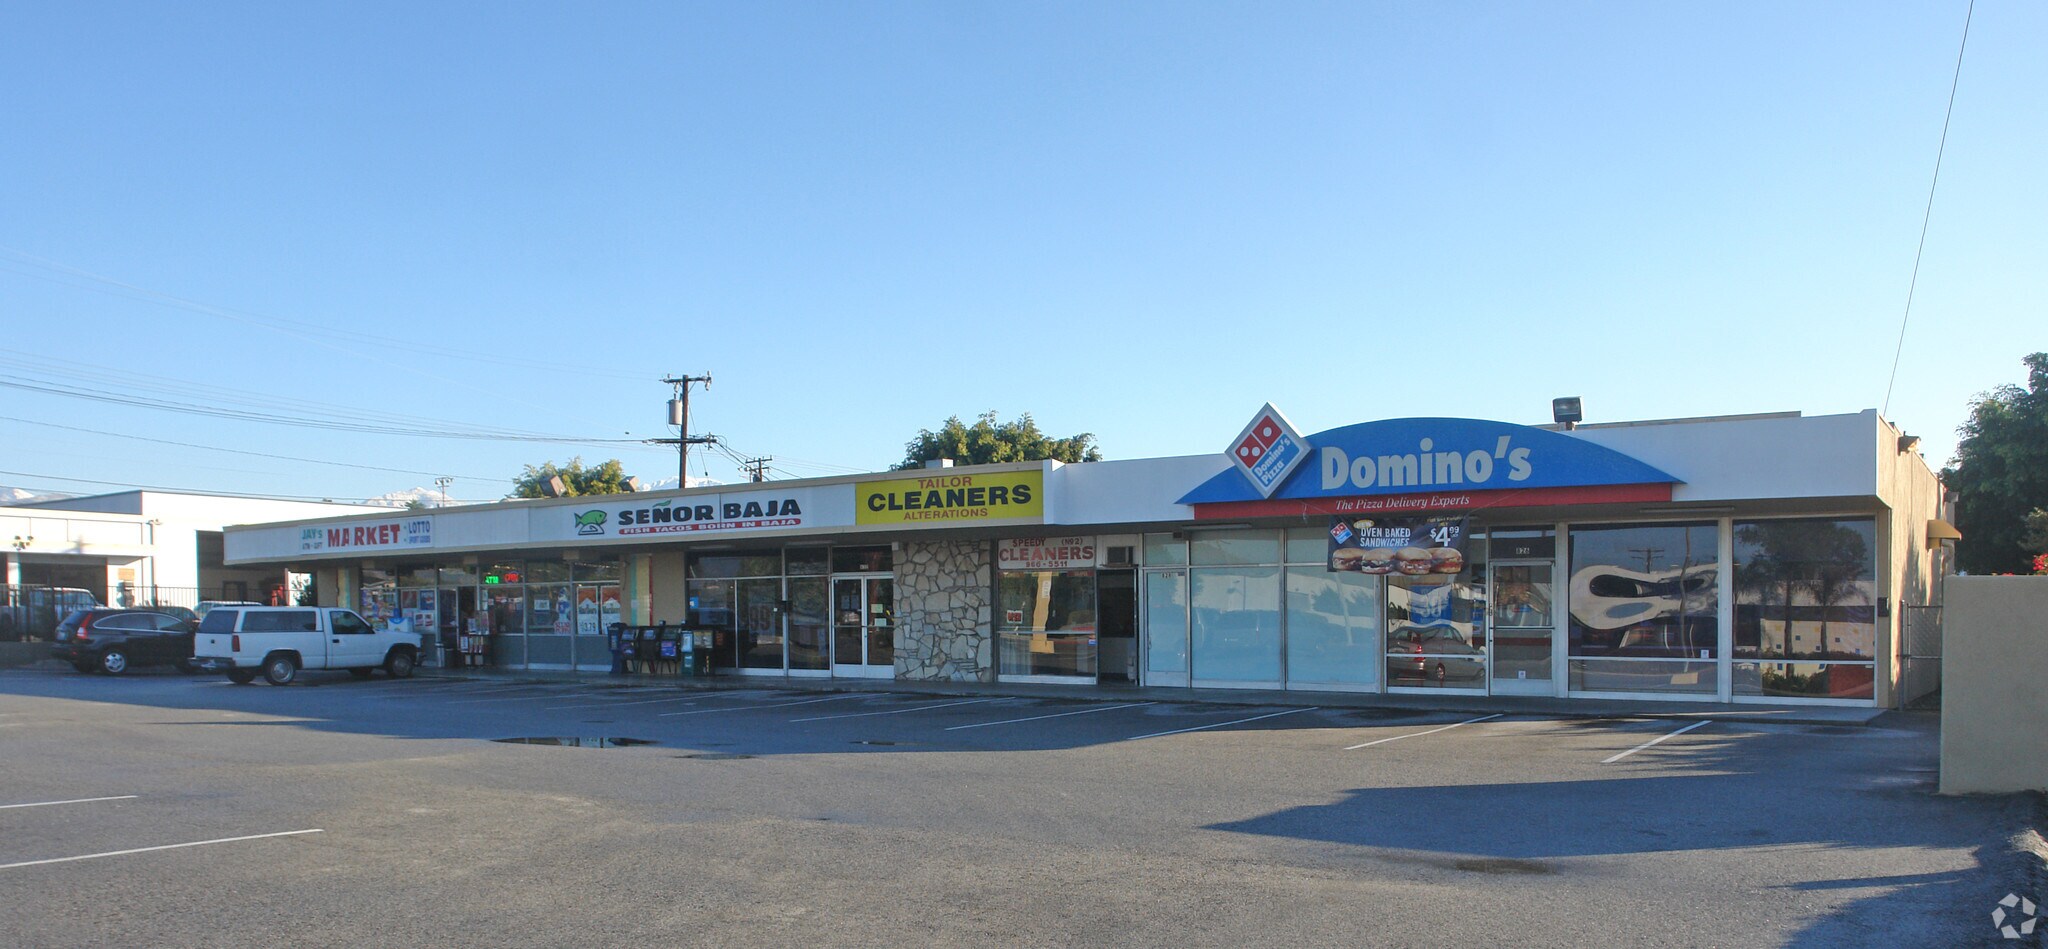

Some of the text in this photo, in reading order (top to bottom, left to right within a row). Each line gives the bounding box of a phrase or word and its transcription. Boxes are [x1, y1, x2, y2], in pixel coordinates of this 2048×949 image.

[1253, 438, 1291, 477] Domino's
[1321, 435, 1532, 490] Domino's
[1260, 460, 1285, 485] Pizza
[918, 476, 972, 489] TAILOR
[867, 484, 1032, 512] CLEANERS
[1335, 495, 1470, 510] The Pizza Delivery Experts
[618, 499, 802, 526] SEÑOR BAJA
[903, 507, 988, 521] ALTERATIONS
[408, 520, 431, 534] LOTTO
[655, 525, 693, 533] TACOS
[698, 522, 736, 530] BORN
[761, 518, 797, 526] BAJA
[1361, 527, 1382, 538] OVEN
[1385, 527, 1411, 538] BAKED
[327, 523, 401, 548] MARKET
[1012, 537, 1046, 548] SPEEDY
[1360, 537, 1410, 547] SANDWICHES
[999, 545, 1094, 562] CLEANERS
